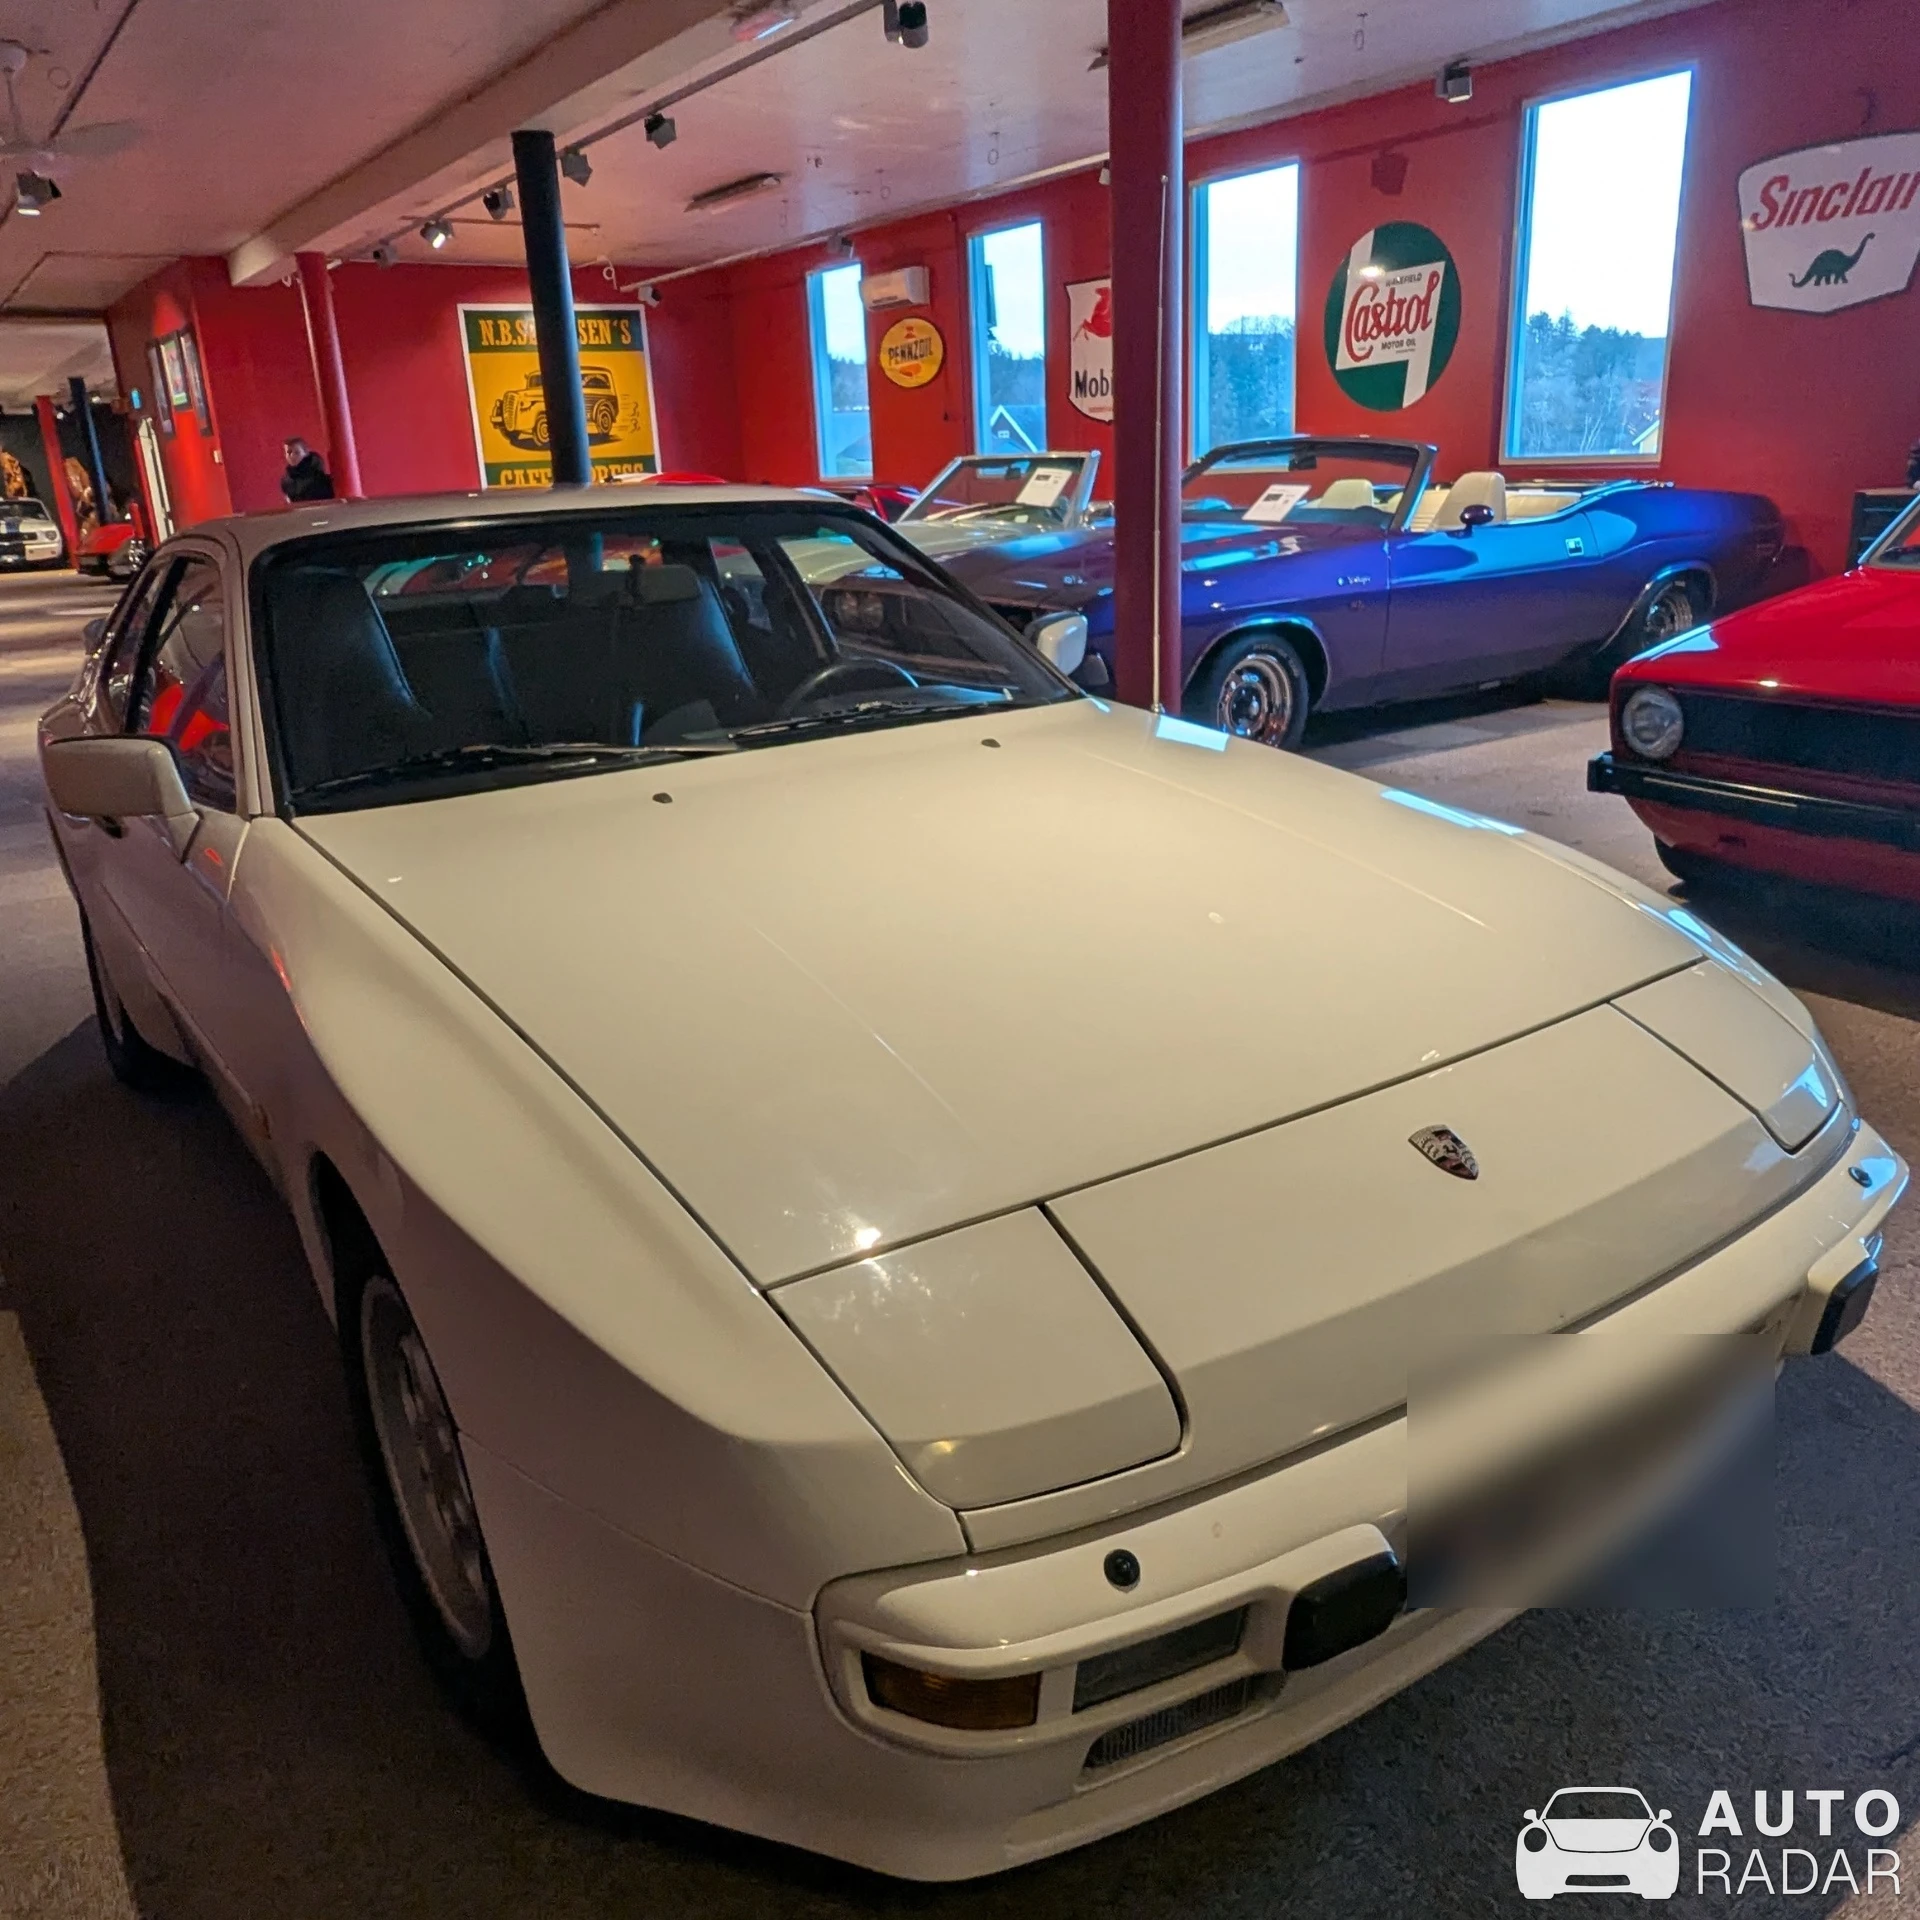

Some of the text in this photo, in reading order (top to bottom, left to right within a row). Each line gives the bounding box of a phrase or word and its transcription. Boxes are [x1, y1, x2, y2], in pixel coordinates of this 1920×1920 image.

[1345, 270, 1441, 362] Castrol
[888, 336, 934, 367] PENNZOIL
[1381, 338, 1417, 349] MOTOR OIL
